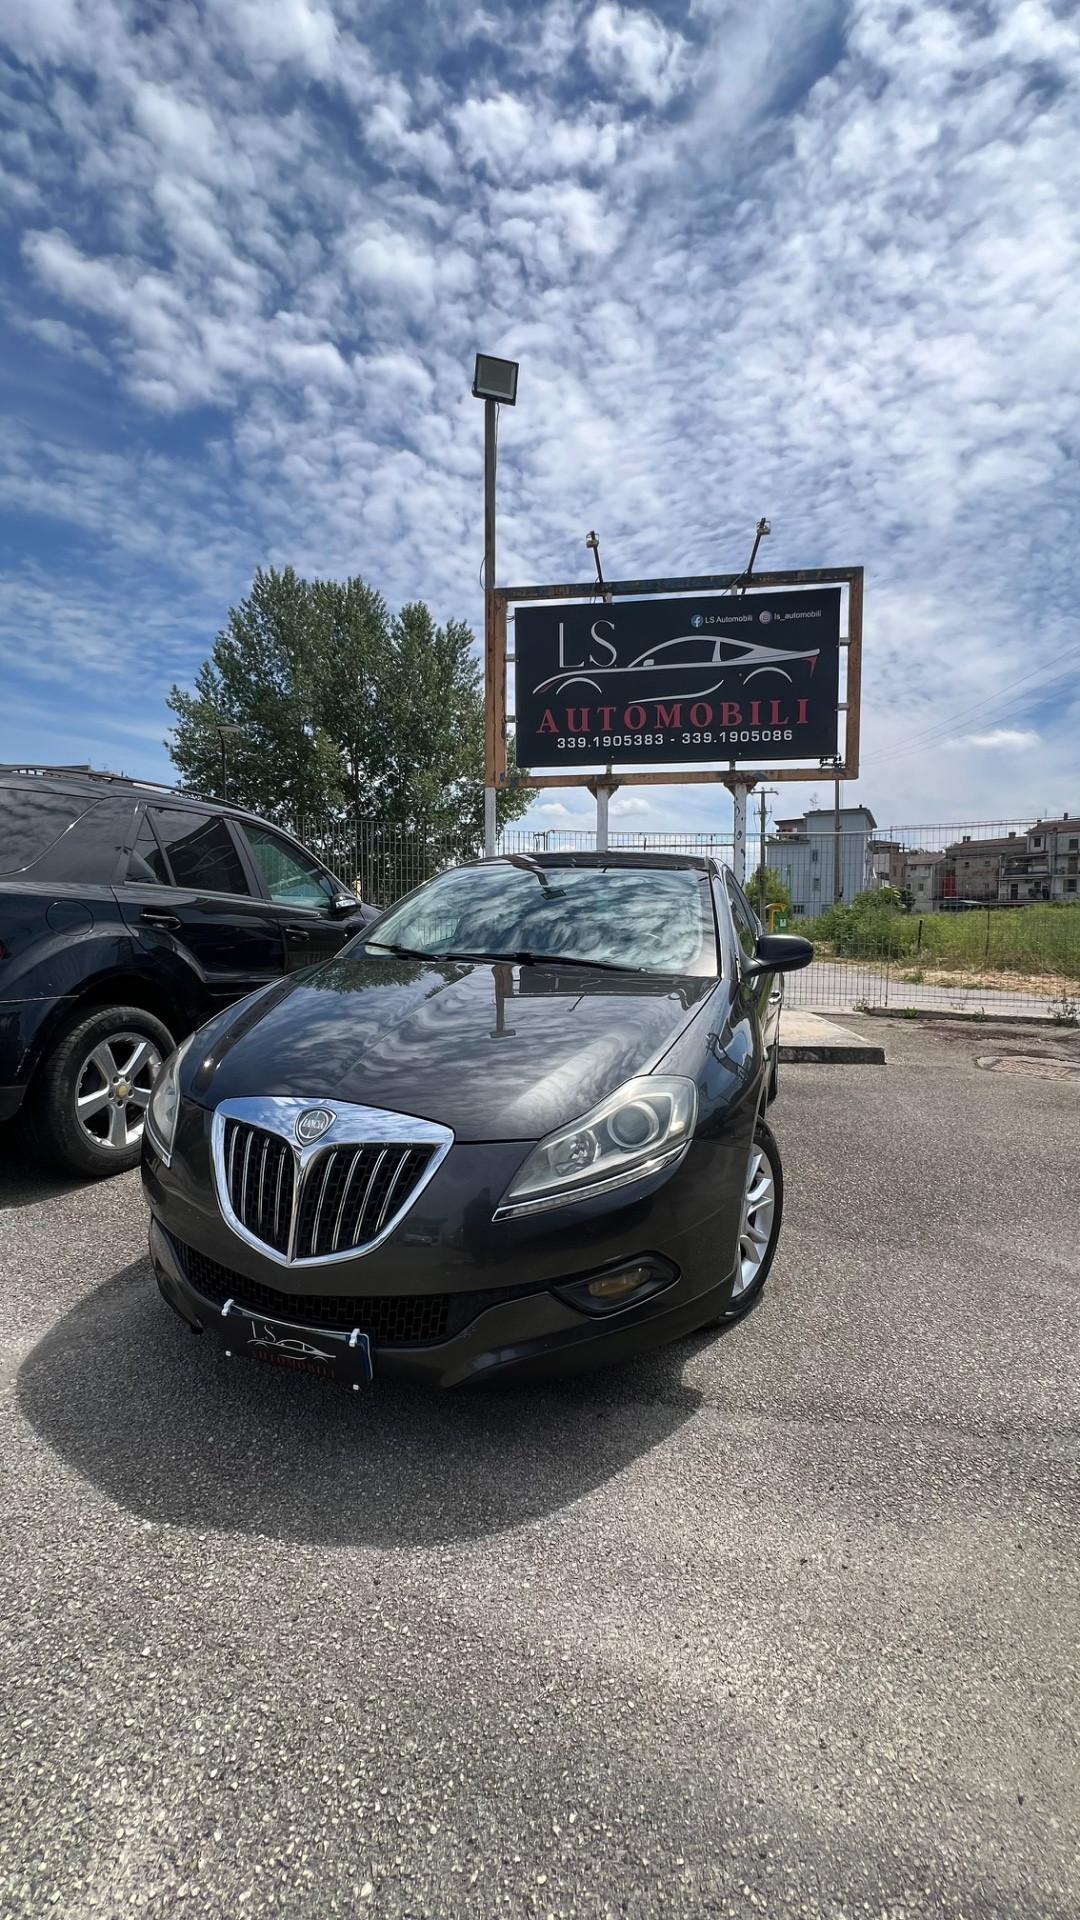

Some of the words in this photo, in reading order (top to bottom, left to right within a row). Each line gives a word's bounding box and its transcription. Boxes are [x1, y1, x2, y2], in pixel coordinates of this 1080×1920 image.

[704, 616, 715, 625] LS
[716, 614, 753, 624] Automobili
[559, 619, 617, 668] LS
[536, 698, 809, 733] AUTOMOBILI
[557, 733, 664, 749] 339.1905383
[681, 729, 793, 744] 339.1905086
